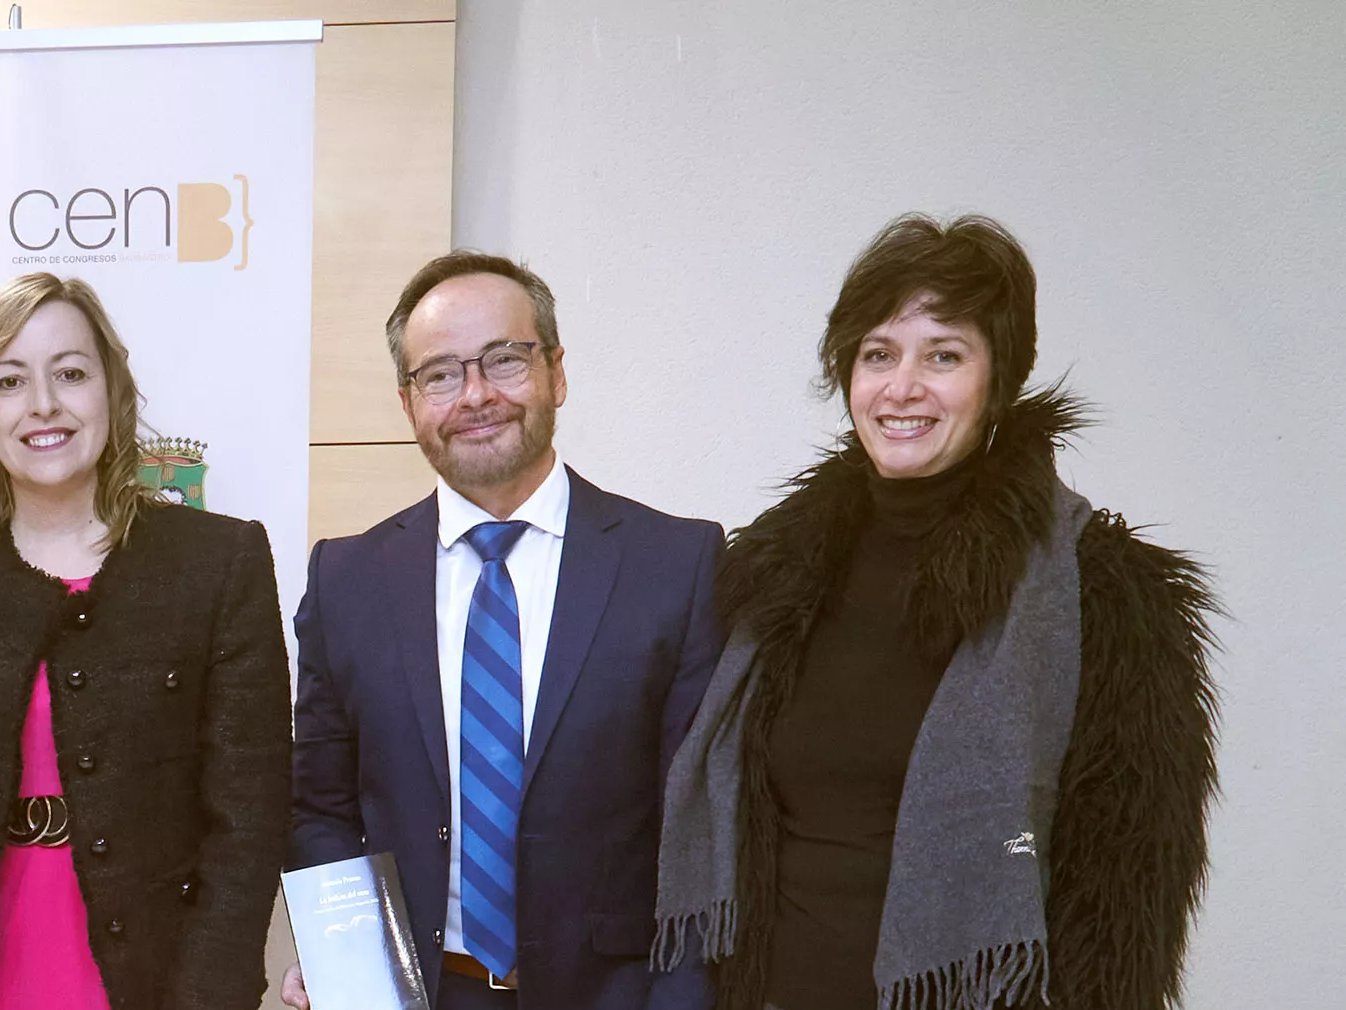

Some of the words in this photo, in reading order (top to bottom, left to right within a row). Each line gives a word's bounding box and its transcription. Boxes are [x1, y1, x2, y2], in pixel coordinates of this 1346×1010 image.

[12, 256, 47, 264] CENTRO
[49, 256, 61, 264] DE
[62, 254, 117, 264] CONGRESOS
